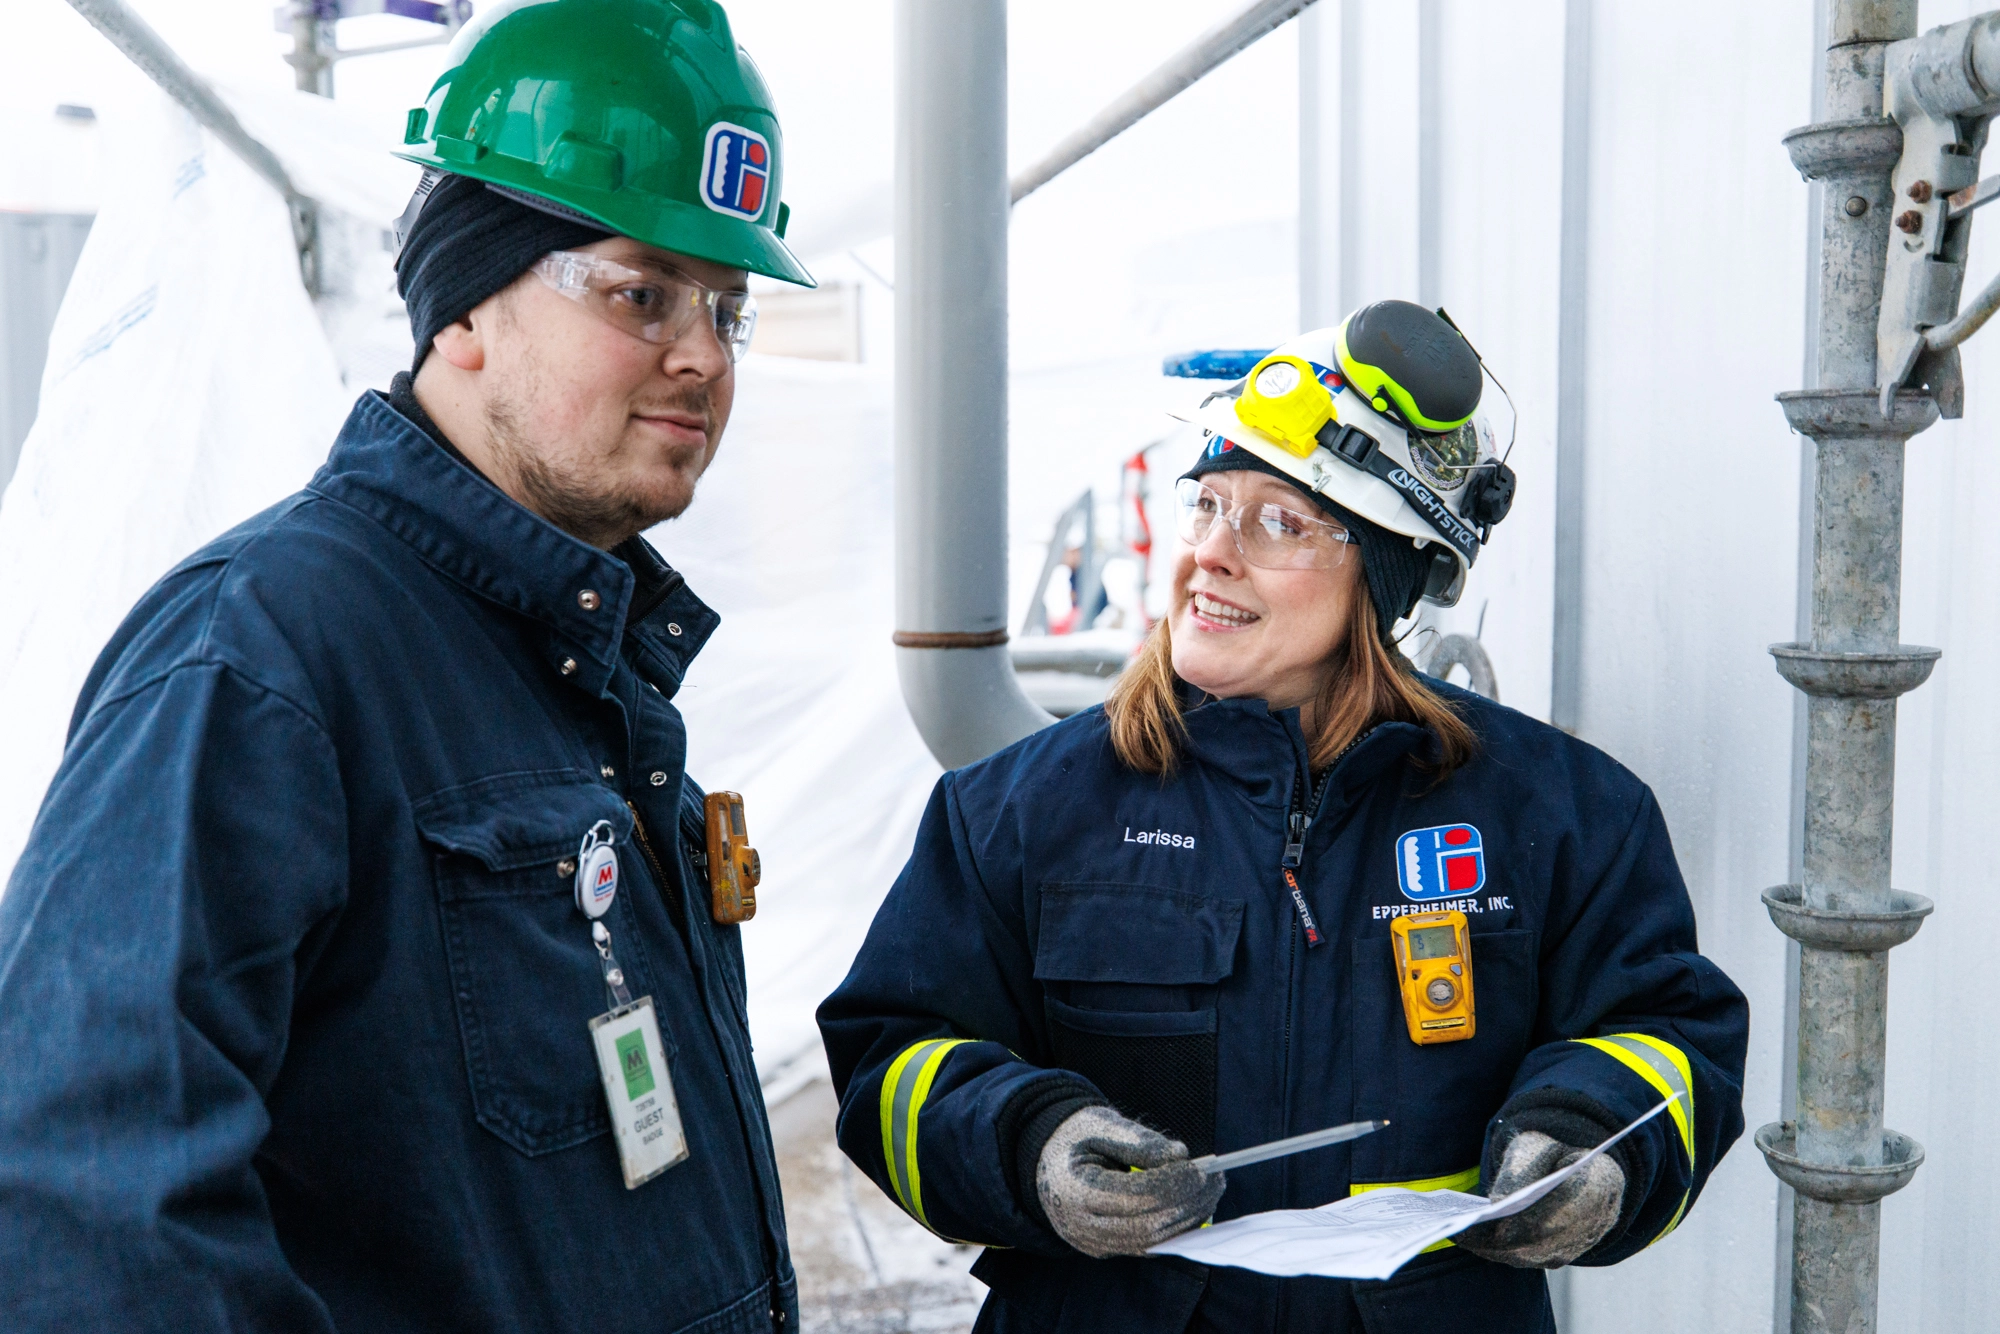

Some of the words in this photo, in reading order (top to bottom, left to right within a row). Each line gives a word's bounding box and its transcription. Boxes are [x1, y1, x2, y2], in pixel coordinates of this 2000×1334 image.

[1397, 469, 1476, 549] NIGHTSTICK
[1123, 826, 1196, 850] Larissa
[1487, 896, 1514, 911] INC.
[633, 1107, 664, 1133] GUEST
